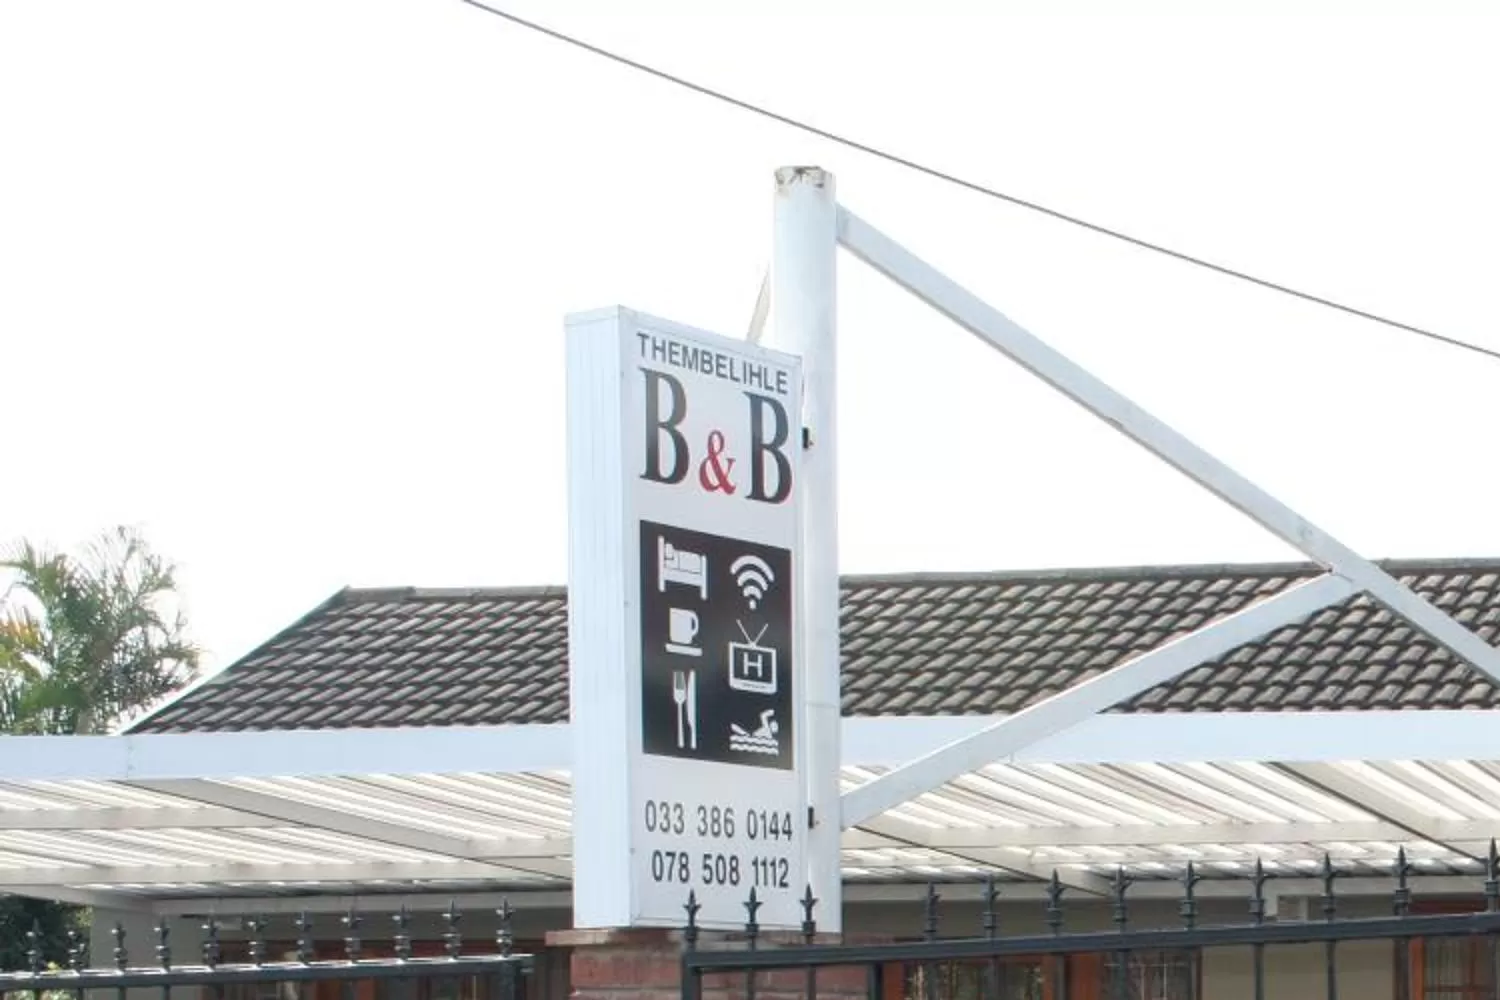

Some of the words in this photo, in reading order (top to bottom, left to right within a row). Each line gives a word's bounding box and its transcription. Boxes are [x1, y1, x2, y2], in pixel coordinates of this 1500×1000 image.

[637, 332, 788, 395] THEMBELIHLE
[743, 653, 763, 678] H
[645, 800, 685, 835] 033
[697, 805, 735, 839] 386
[747, 810, 793, 841] 0144
[652, 850, 690, 884] 078
[702, 854, 740, 887] 508
[752, 857, 789, 889] 1112
